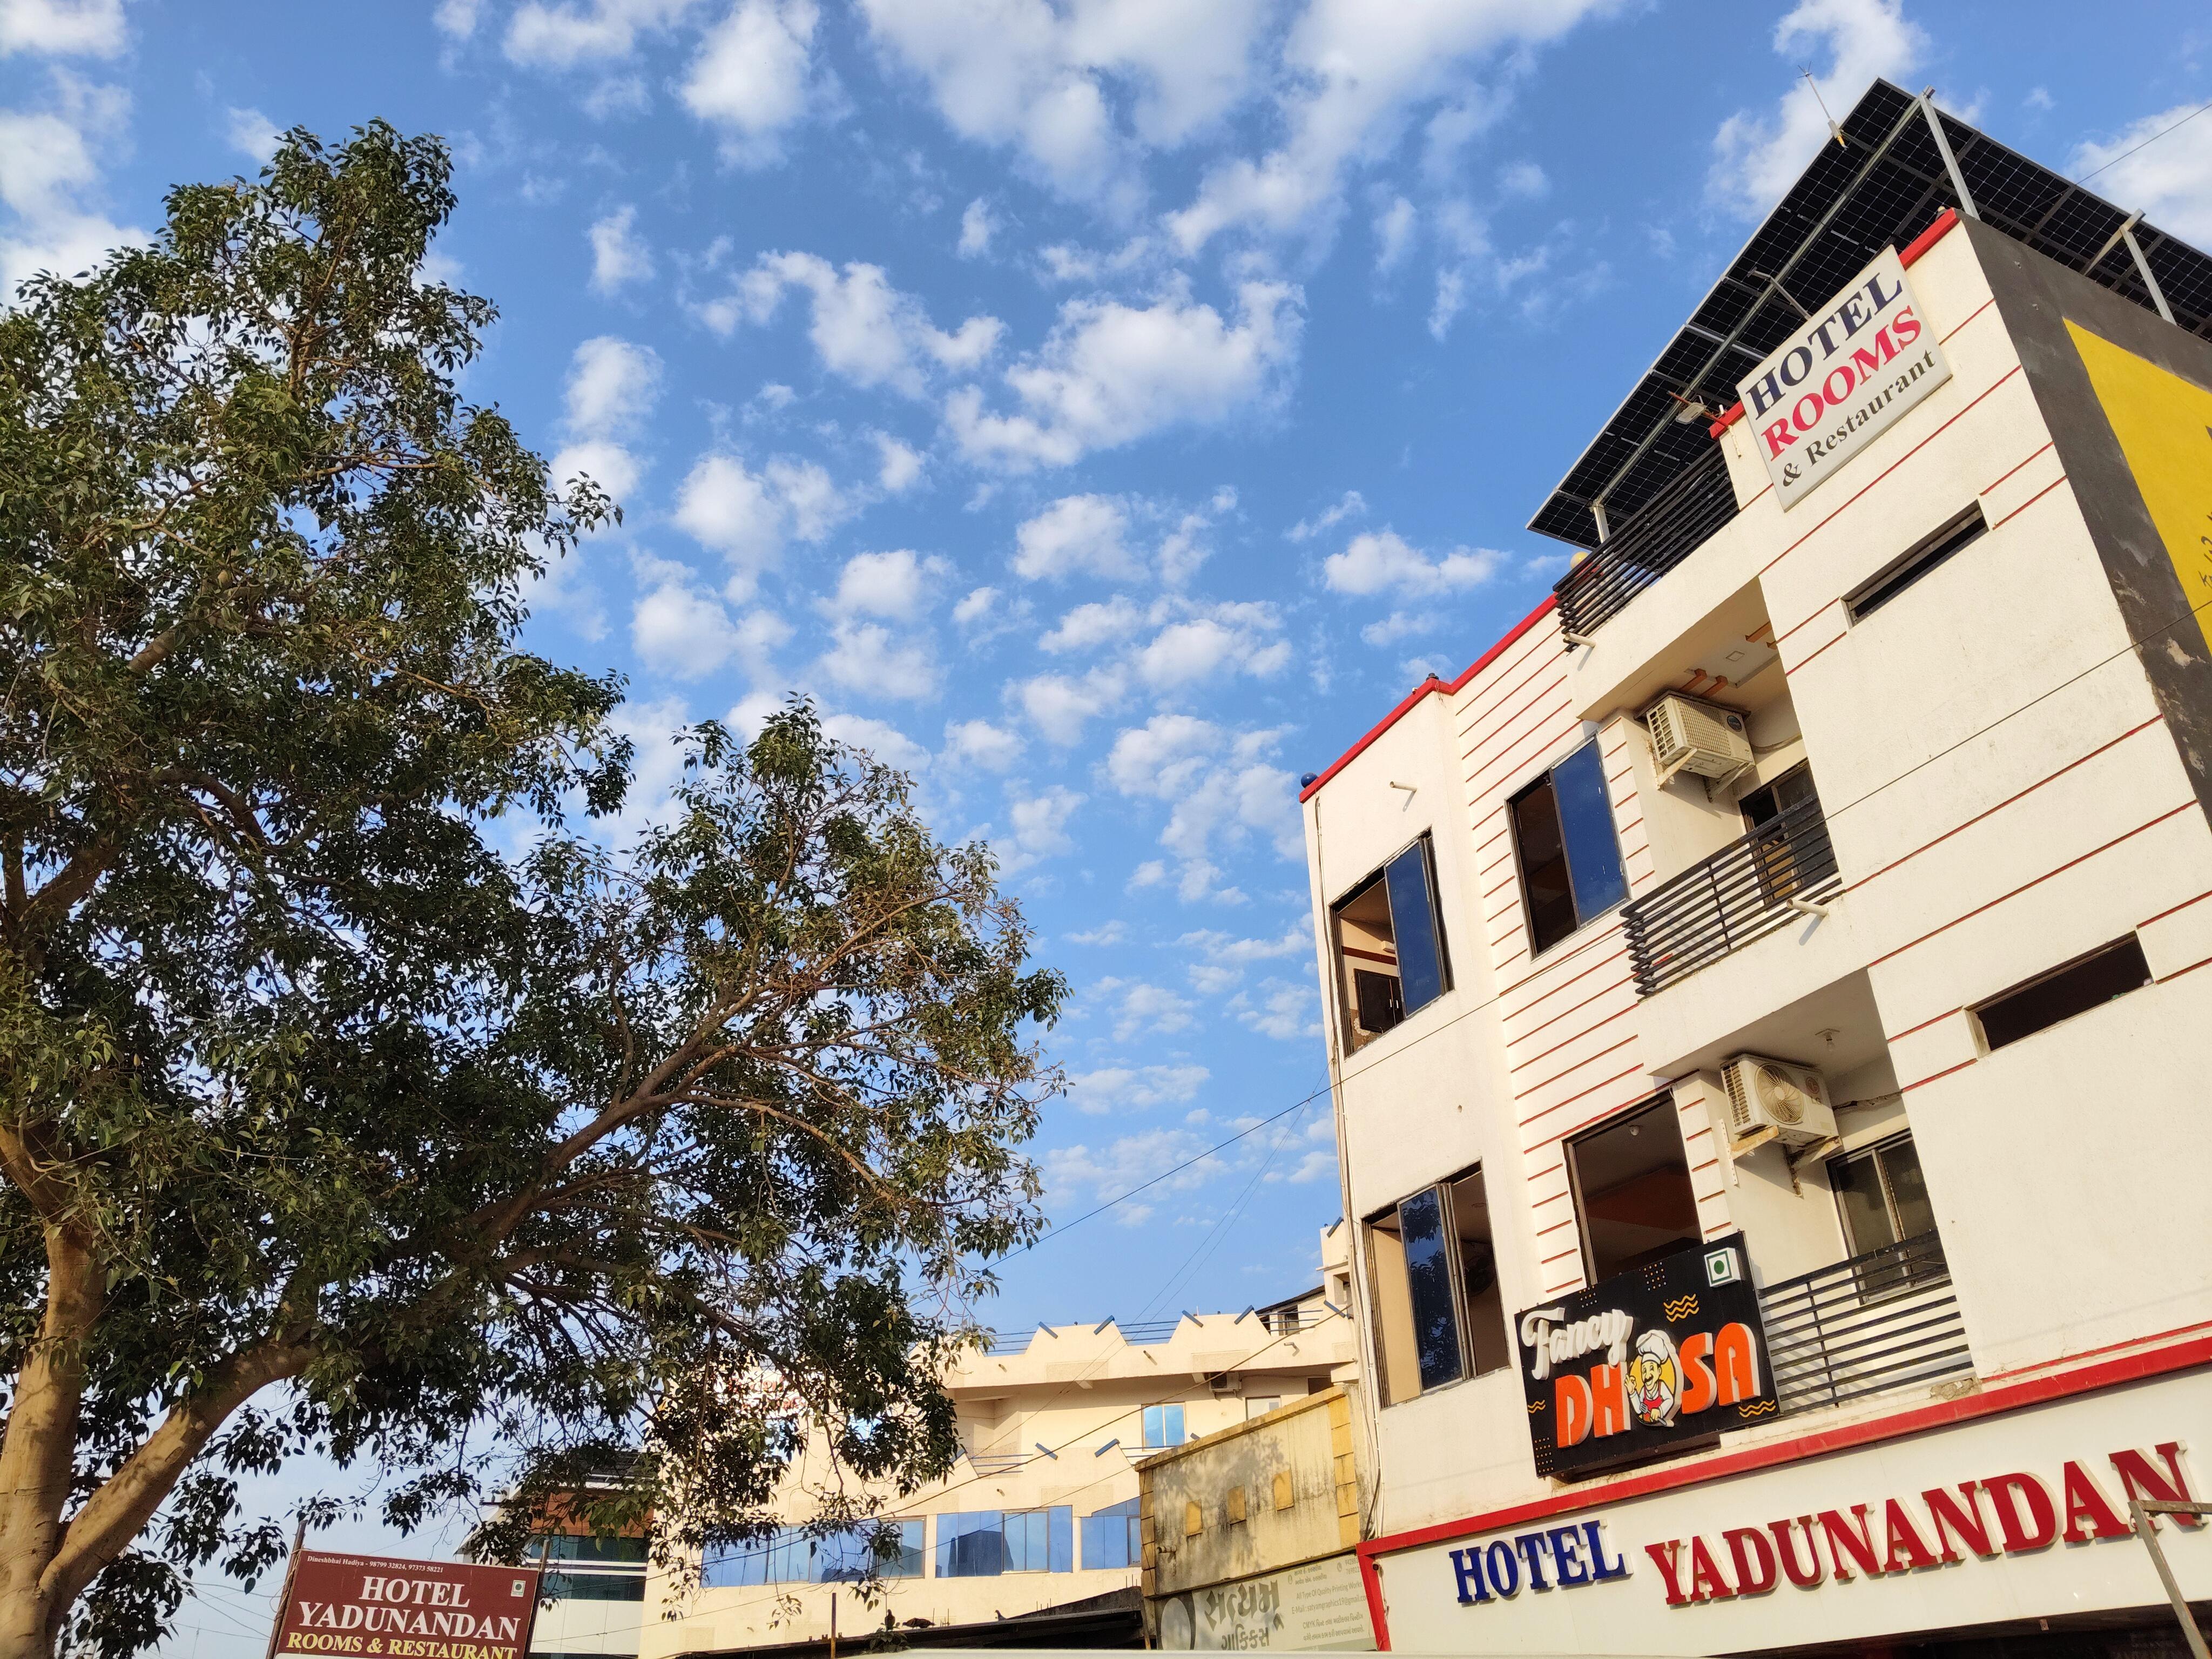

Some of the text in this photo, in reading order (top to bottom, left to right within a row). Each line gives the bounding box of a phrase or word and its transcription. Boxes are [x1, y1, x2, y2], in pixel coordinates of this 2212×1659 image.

[1745, 272, 1903, 420] HOTEL
[1761, 305, 1921, 461] ROOMS
[1782, 349, 1936, 487] & Restaurant
[1521, 1307, 1633, 1380] Fancy
[1448, 1441, 2202, 1606] HOTEL YADUNANDAN
[307, 1555, 341, 1564] Dineshbhai
[342, 1559, 365, 1567] Hadiya
[359, 1575, 470, 1608] HOTEL
[1302, 1591, 1311, 1600] Type
[1317, 1587, 1331, 1596] Quality
[1332, 1584, 1348, 1592] Printing
[1348, 1581, 1363, 1589] Works
[298, 1601, 521, 1641] YADUNANDAN
[1303, 1620, 1316, 1629] CMYK
[286, 1632, 517, 1659] ROOMS & RESTAURANT
